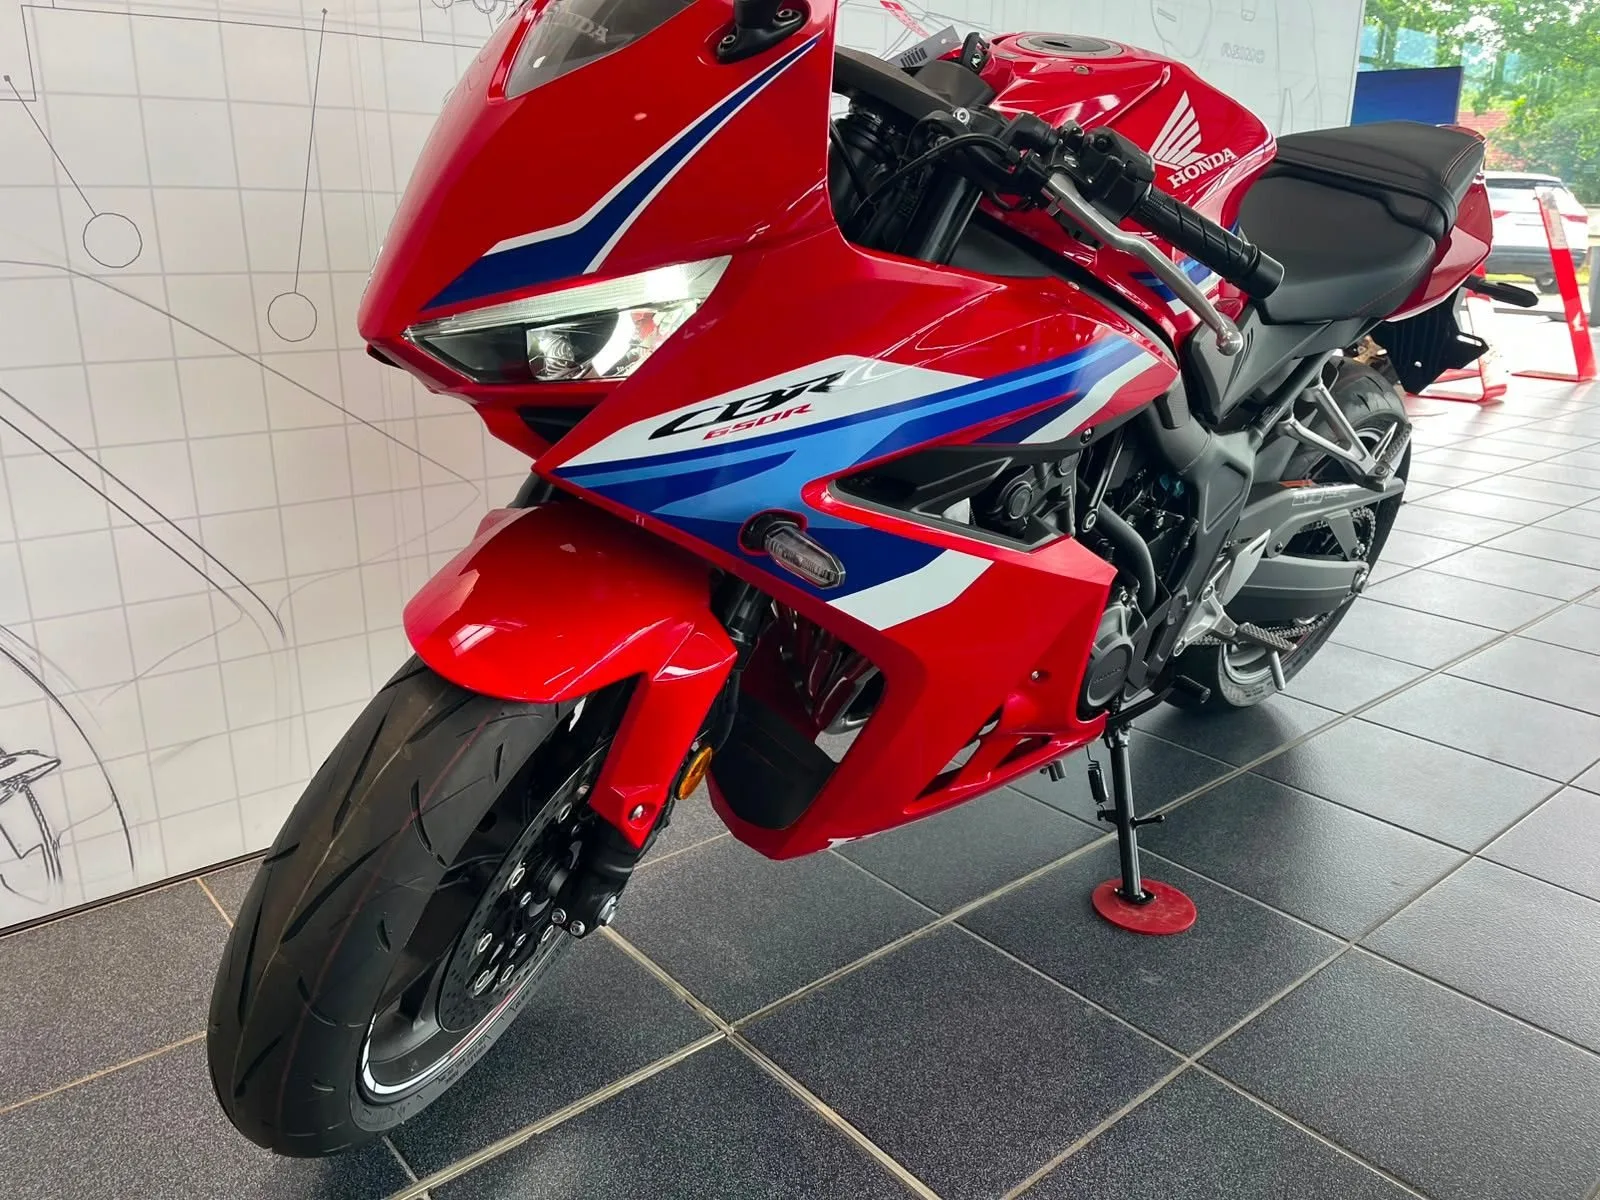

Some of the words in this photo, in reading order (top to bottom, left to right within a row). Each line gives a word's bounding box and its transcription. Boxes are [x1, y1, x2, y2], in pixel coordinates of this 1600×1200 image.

[1167, 147, 1239, 190] HONDA
[648, 370, 846, 440] CBR
[703, 403, 812, 440] 650R
